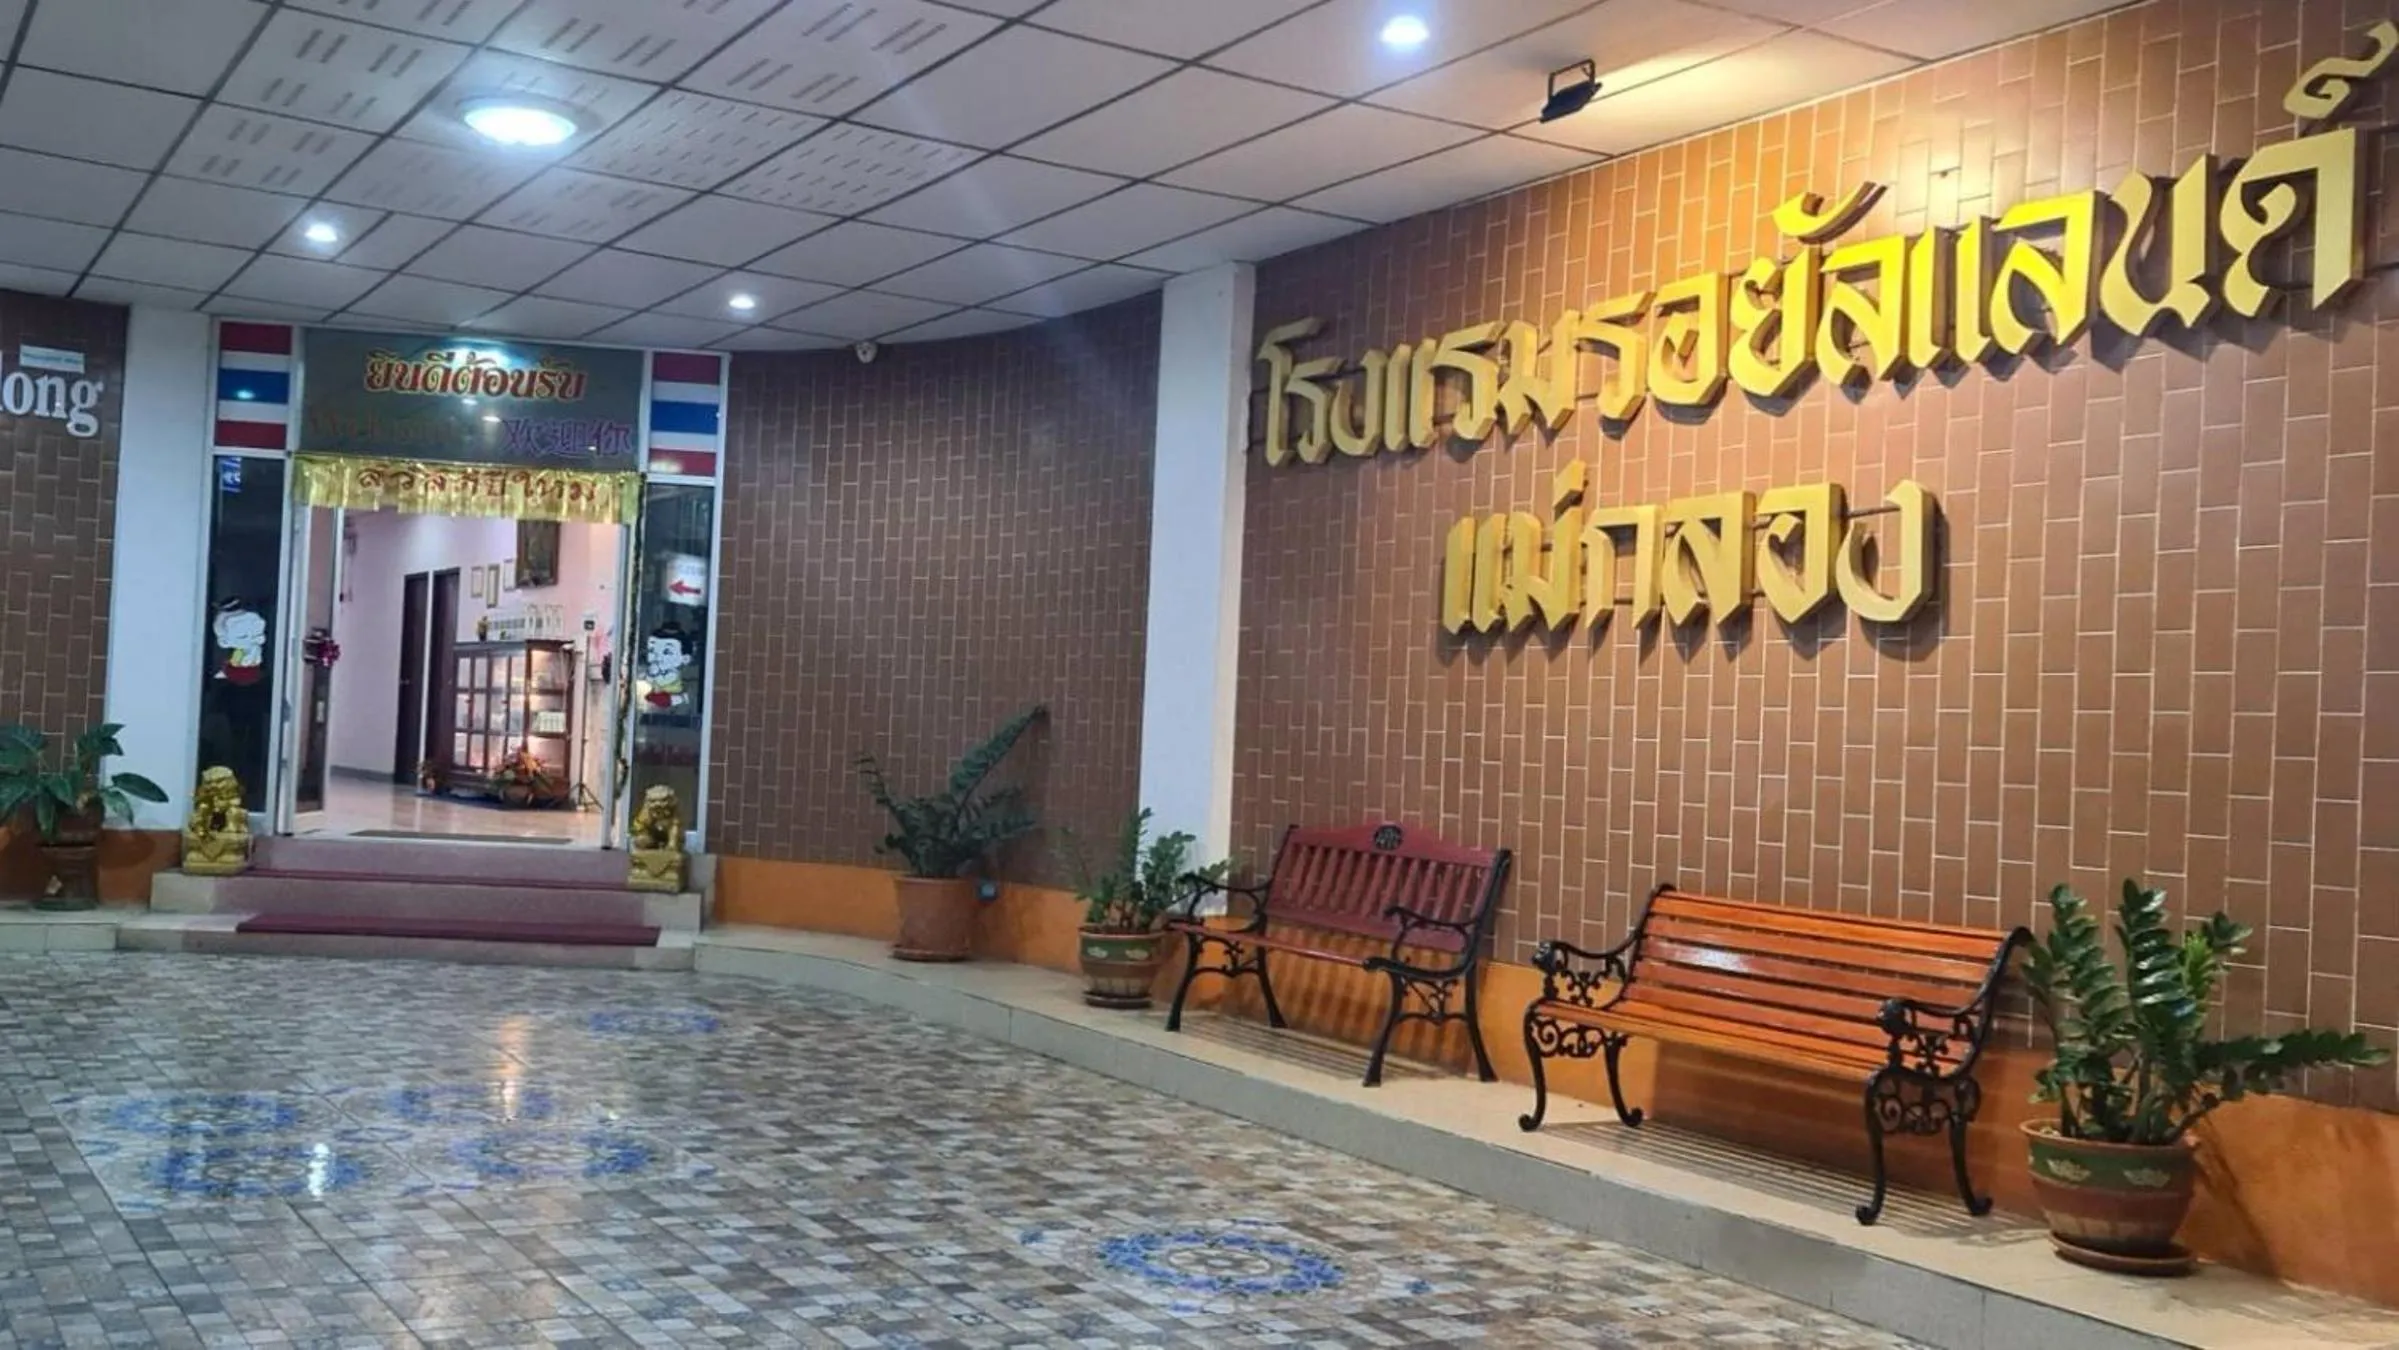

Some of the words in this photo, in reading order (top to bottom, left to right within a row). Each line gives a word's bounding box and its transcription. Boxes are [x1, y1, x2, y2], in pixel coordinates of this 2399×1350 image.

[0, 350, 103, 437] ong
[364, 348, 587, 399] ยินดีต้อนรับ
[357, 463, 596, 502] สวัสดีปีใหม
[1442, 458, 1936, 635] แม่กลอง
